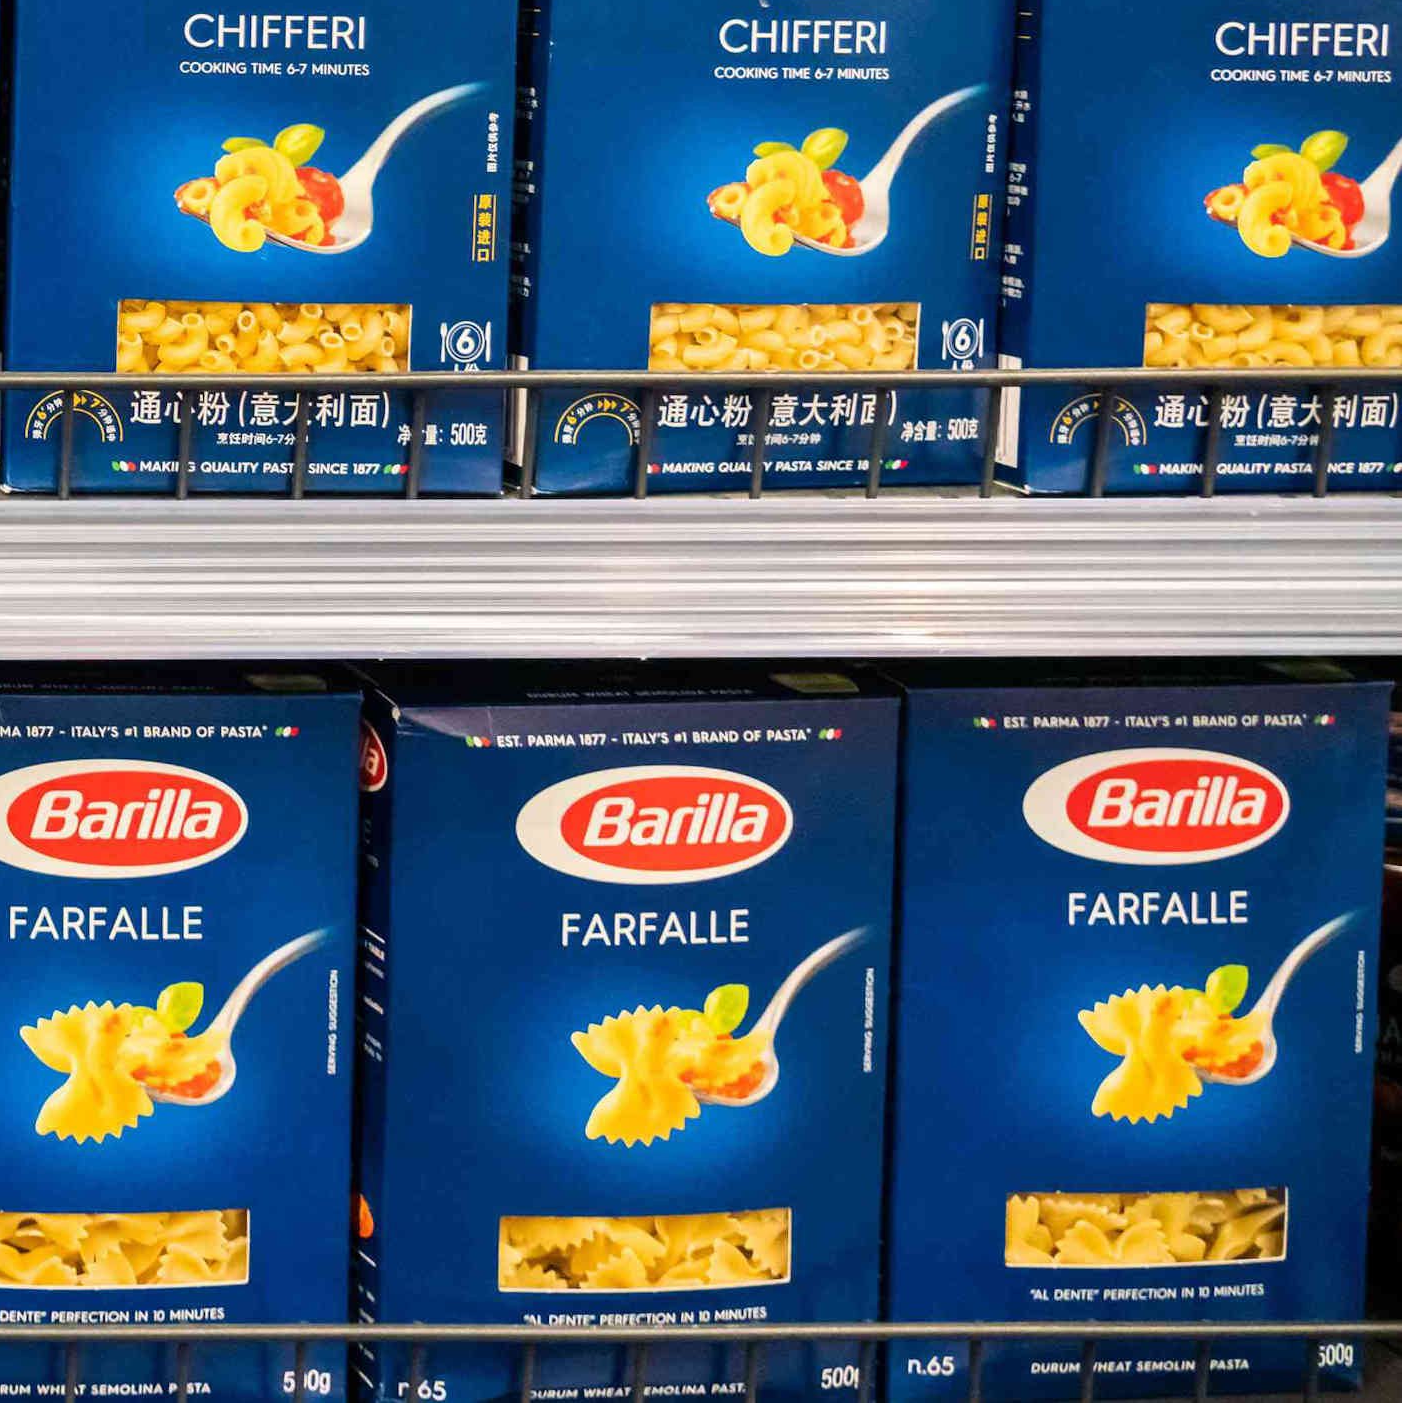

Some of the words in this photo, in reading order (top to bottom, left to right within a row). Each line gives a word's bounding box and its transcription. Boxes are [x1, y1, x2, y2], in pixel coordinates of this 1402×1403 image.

[184, 14, 365, 49] CHIFFERI
[720, 19, 886, 53] CHIFFERI
[1216, 22, 1388, 56] CHIFFERI
[1211, 69, 1276, 81] COOKING
[1280, 70, 1309, 82] TIME
[1314, 70, 1333, 82] 6-7
[1338, 71, 1391, 82] MINUTES
[201, 462, 258, 473] QUALITY
[308, 463, 348, 474] SINCE
[353, 463, 380, 474] 1877
[30, 788, 223, 840] Barilla
[1087, 776, 1266, 827] Barilla
[583, 793, 768, 846] Barilla
[10, 906, 202, 940] FARFALLE
[1069, 891, 1247, 925] FARFALLE
[562, 909, 749, 946] FARFALLE
[1104, 1288, 1176, 1300] PERFECTION
[1181, 1288, 1194, 1298] IN
[1199, 1286, 1209, 1298] 10
[1214, 1284, 1264, 1296] MINUTES
[908, 1356, 954, 1375] n.65
[92, 1384, 162, 1395] SEMOLINA
